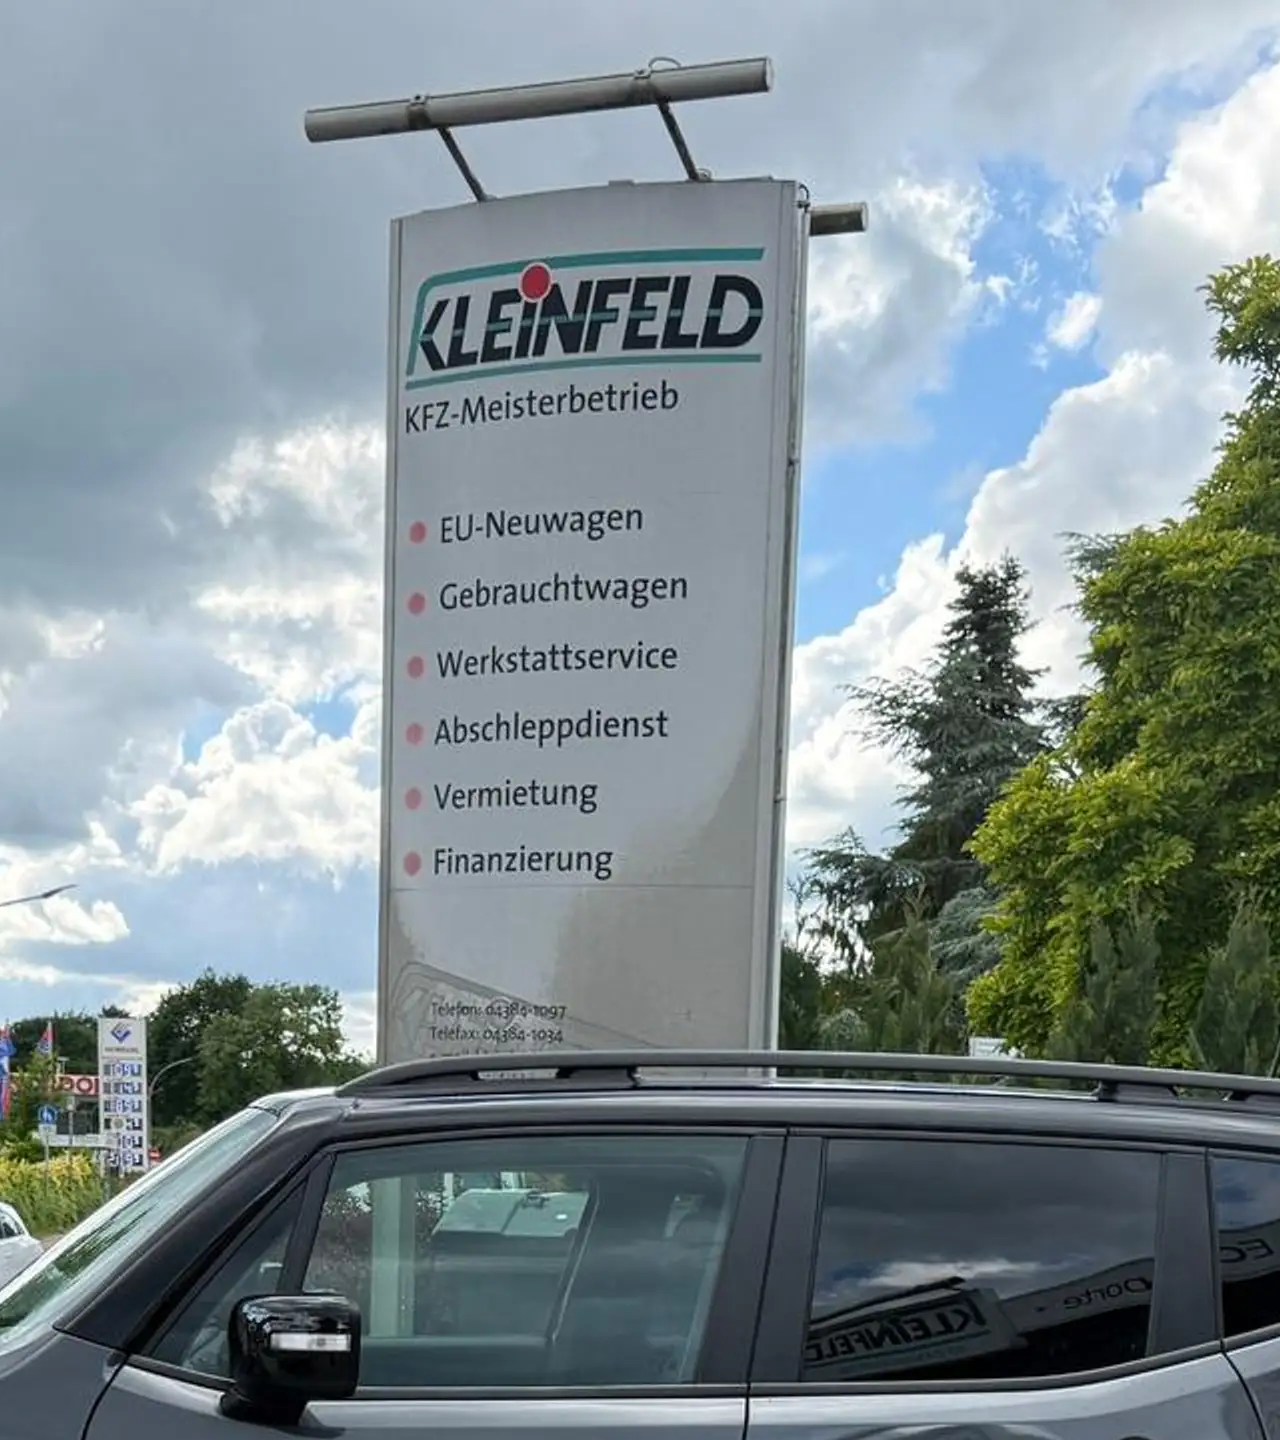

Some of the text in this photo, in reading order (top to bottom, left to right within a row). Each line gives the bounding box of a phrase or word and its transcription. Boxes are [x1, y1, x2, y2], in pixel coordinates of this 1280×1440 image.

[420, 262, 764, 371] KLEINFELD
[405, 380, 679, 434] KFZ-Meisterbetrieb
[440, 506, 644, 544] EU-Neuwagen
[439, 572, 689, 612] Gebrauchtwagen
[437, 641, 679, 678] Werkstattservice
[435, 709, 669, 748] Abschleppdienst
[434, 779, 598, 814] Vermietung
[434, 843, 614, 881] Finanzierung
